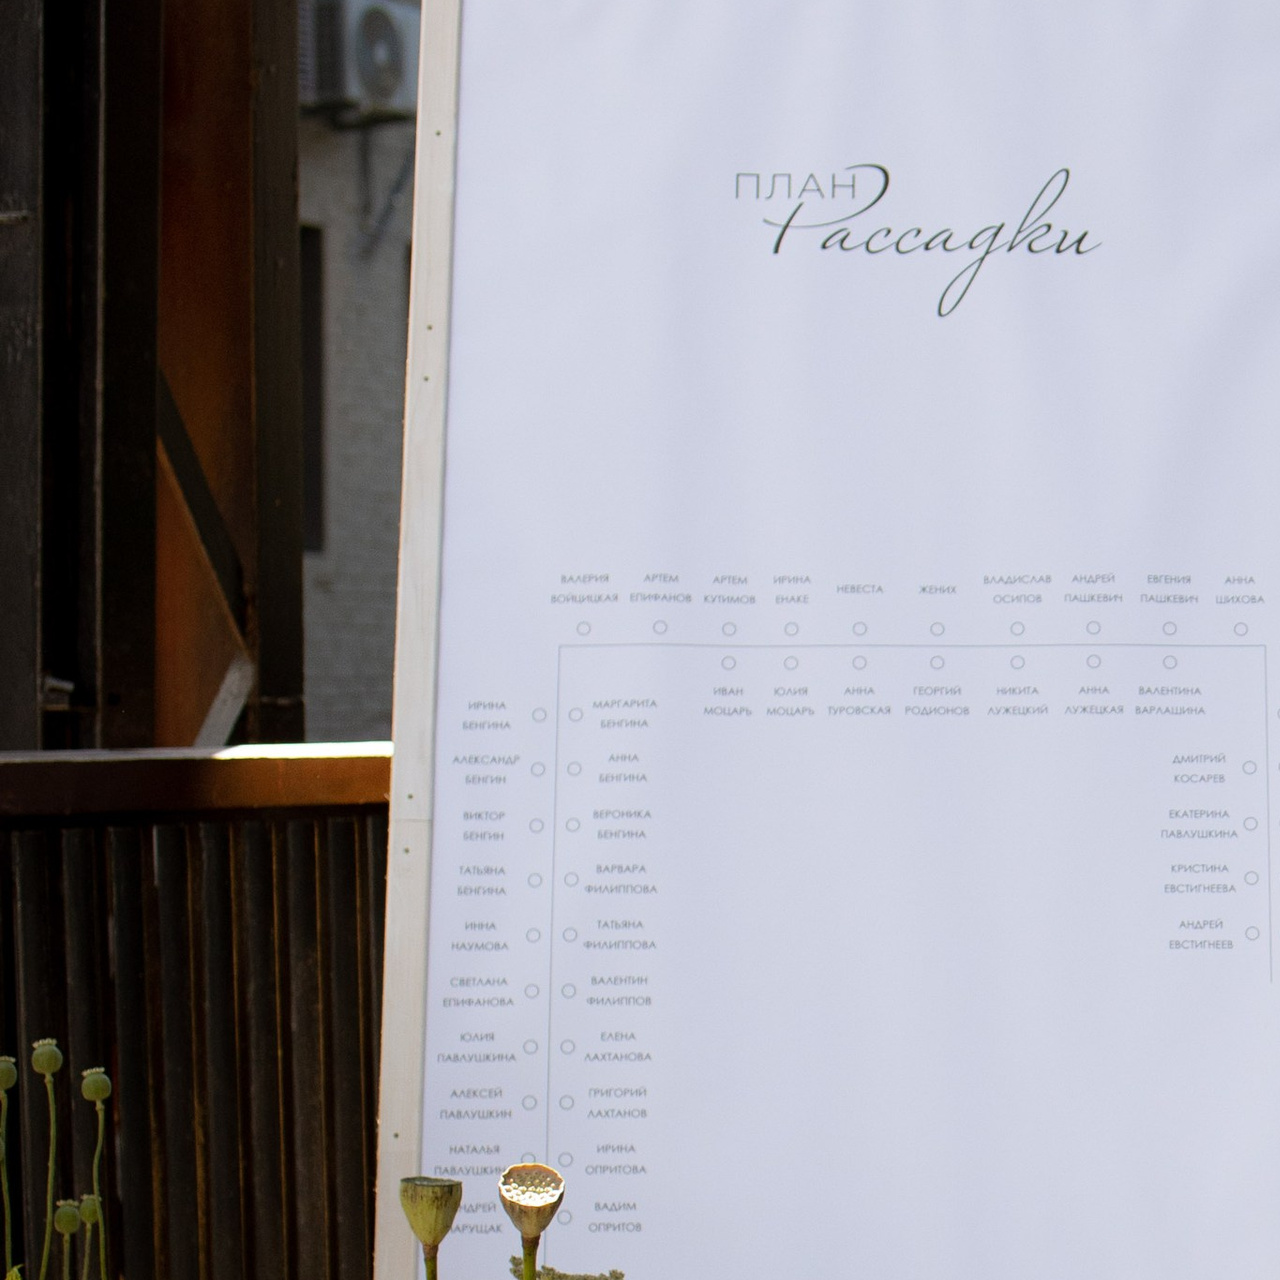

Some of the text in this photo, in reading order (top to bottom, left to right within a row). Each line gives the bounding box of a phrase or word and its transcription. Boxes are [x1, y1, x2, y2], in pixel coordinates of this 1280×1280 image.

[735, 172, 858, 200] ПЛАН
[762, 163, 1102, 318] Рассадки
[559, 573, 610, 584] ВАЛЕРИЯ
[642, 572, 680, 583] АРТЕМ
[711, 574, 748, 586] АРТЕМ
[772, 574, 811, 586] ИРИНА
[982, 574, 1052, 585] ВЛАДИСЛАВ
[1070, 573, 1116, 584] АНДРЕЙ
[1146, 574, 1192, 585] ЕВГЕНИЯ
[1223, 575, 1255, 586] АННА
[835, 583, 884, 595] НЕВЕСТА
[918, 584, 957, 595] ЖЕНИХ
[549, 593, 619, 604] ВОЙЦИЦКАЯ
[628, 592, 693, 603] ЕПИФАНОВ
[991, 593, 1043, 604] ОСИПОВ
[1063, 592, 1123, 604] ПАШКЕВИЧ
[1139, 593, 1199, 604] ПАШКЕВИЧ
[1214, 594, 1265, 605] ШИХОВА
[711, 686, 744, 697] ИВАН
[772, 686, 809, 697] ЮЛИЯ
[842, 685, 875, 696] АННА
[912, 685, 962, 696] ГЕОРГИЙ
[995, 685, 1039, 696] НИКИТА
[1077, 685, 1110, 696] АННА
[1137, 685, 1202, 696] ВАЛЕНТИНА
[467, 699, 507, 711] ИРИНА
[591, 698, 658, 709] МАРГАРИТА
[702, 706, 753, 717] МОЦАРЬ
[765, 706, 815, 717] МОЦАРЬ
[827, 705, 892, 716] ТУРОВСКАЯ
[904, 705, 971, 717] РОДИОНОВ
[986, 705, 1049, 716] ЛУЖЕЦКИЙ
[1063, 704, 1124, 715] ЛУЖЕЦКАЯ
[461, 719, 511, 731] БЕНГИНА
[599, 718, 649, 729] БЕНГИНА
[451, 754, 521, 766] АЛЕКСАНДР
[607, 752, 640, 763] АННА
[1171, 754, 1226, 765] ДМИТРИЙ
[463, 774, 507, 785] БЕНГИН
[597, 772, 648, 784] БЕНГИНА
[1172, 773, 1226, 784] КОСАРЕВ
[461, 810, 506, 821] ВИКТОР
[591, 808, 652, 820] ВЕРОНИКА
[1167, 808, 1230, 820] ЕКАТЕРИНА
[461, 830, 505, 841] БЕНГИН
[596, 829, 646, 840] БЕНГИНА
[1159, 828, 1238, 840] ПАВЛУШКИНА
[458, 865, 506, 876] ТАТЬЯНА
[594, 863, 646, 874] ВАРВАРА
[1169, 863, 1229, 874] КРИСТИНА
[456, 885, 507, 896] БЕНГИНА
[583, 884, 658, 895] ФИЛИППОВА
[1163, 883, 1237, 894] ЕВСТИГНЕЕВА
[463, 920, 497, 932] ИННА
[596, 919, 644, 930] ТАТЬЯНА
[1178, 919, 1224, 930] АНДРЕЙ
[449, 941, 509, 952] НАУМОВА
[581, 939, 657, 950] ФИЛИППОВА
[1167, 939, 1234, 950] ЕВСТИГНЕЕВ
[448, 976, 508, 988] СВЕТЛАНА
[589, 975, 649, 986] ВАЛЕНТИН
[441, 997, 514, 1008] ЕПИФАНОВА
[585, 995, 652, 1007] ФИЛИППОВ
[458, 1031, 495, 1043] ЮЛИЯ
[599, 1031, 637, 1042] ЕЛЕНА
[435, 1052, 517, 1064] ПАВЛУШКИНА
[583, 1051, 652, 1062] ЛАХТАНОВА
[448, 1087, 503, 1099] АЛЕКСЕЙ
[587, 1087, 648, 1098] ГРИГОРИЙ
[438, 1109, 513, 1120] ПАВЛУШКИН
[586, 1108, 648, 1119] ЛАХТАНОВ
[448, 1144, 501, 1156] НАТАЛЬЯ
[595, 1143, 636, 1154] ИРИНА
[433, 1164, 507, 1177] ПАВЛУШКИН
[583, 1164, 647, 1176] ОПРИТОВА
[459, 1200, 497, 1213] НДРЕЙ
[593, 1201, 637, 1213] ВАДИМ
[451, 1223, 503, 1235] АРУЩАК
[586, 1221, 642, 1233] ОПРИТОВ
